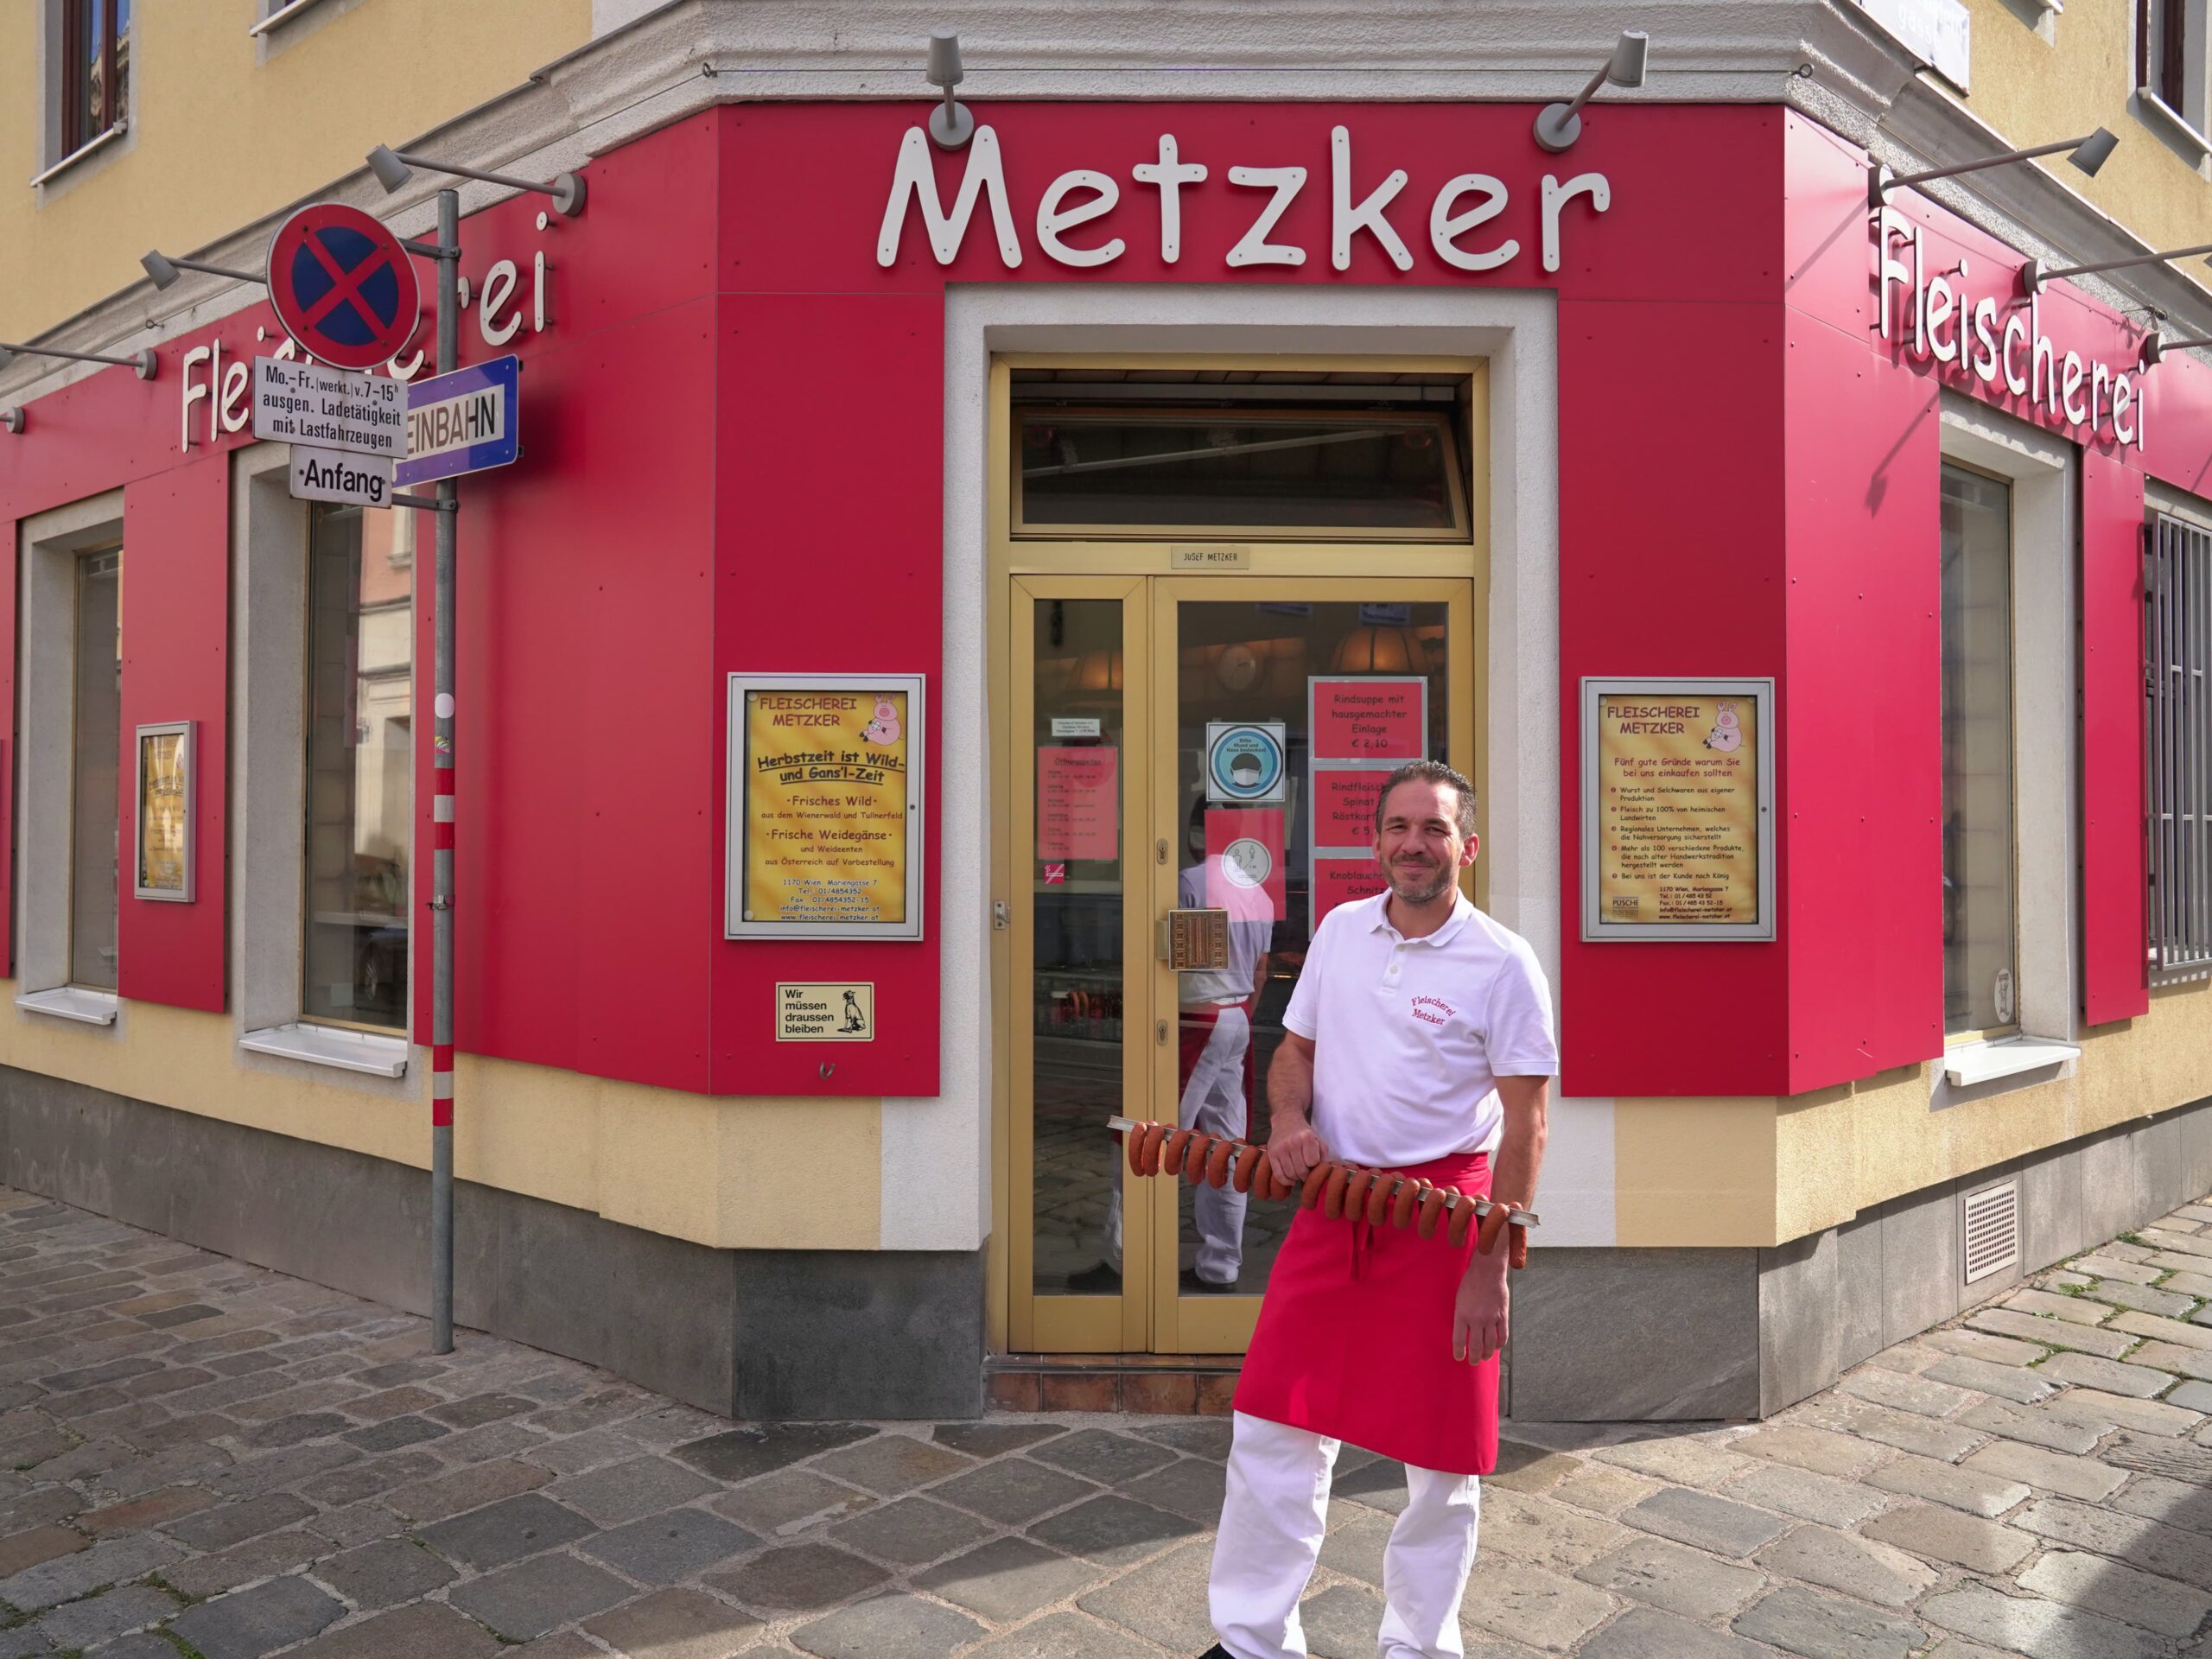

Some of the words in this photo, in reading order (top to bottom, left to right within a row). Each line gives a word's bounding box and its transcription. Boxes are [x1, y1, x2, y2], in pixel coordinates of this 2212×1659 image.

[876, 125, 1610, 272] Metzker
[1878, 206, 2145, 452] Fleischerei
[263, 393, 315, 414] ausgen.
[321, 397, 401, 427] Ladetätigkeit
[408, 393, 495, 455] EINBAHN
[273, 416, 296, 434] mit
[300, 418, 392, 449] Lastfahrzeugen
[303, 459, 384, 503] Anfang
[1207, 552, 1237, 561] METZKER
[760, 697, 857, 710] FLEISCHEREI
[1333, 694, 1383, 705] Rindsuppe
[1388, 695, 1405, 704] mit
[1332, 709, 1408, 721] hausgemachter
[1607, 706, 1700, 719] FLEISCHEREI
[772, 714, 841, 727] METZKER
[1351, 724, 1388, 736] Einlage
[1619, 722, 1685, 734] METZKER
[757, 749, 835, 769] Herbstzeit
[841, 750, 860, 763] ist
[866, 752, 905, 768] Wild-
[1614, 757, 1635, 766] Fünf
[1638, 759, 1657, 768] gute
[1661, 757, 1692, 766] Gründe
[1726, 757, 1741, 766] Sie
[779, 767, 803, 782] und
[1623, 768, 1637, 777] bei
[1658, 768, 1700, 777] einkaufen
[1703, 768, 1732, 777] sollten
[792, 795, 841, 806] Frisches
[845, 795, 873, 806] Wild
[1342, 797, 1376, 808] Spinat
[778, 810, 793, 819] dem
[796, 810, 841, 819] Wienerwald
[843, 810, 857, 819] und
[861, 810, 903, 819] Tullnerfeld
[771, 829, 814, 840] Frische
[819, 829, 887, 842] Weidegänse
[781, 856, 823, 865] Österreich
[826, 857, 839, 866] auf
[842, 858, 895, 868] Vorbestellung
[785, 989, 804, 999] Wir
[785, 1001, 827, 1010] müssen
[1411, 996, 1456, 1016] Fleischerei
[785, 1013, 834, 1022] draussen
[1412, 1008, 1446, 1025] Metzker
[785, 1024, 823, 1033] bleiben
